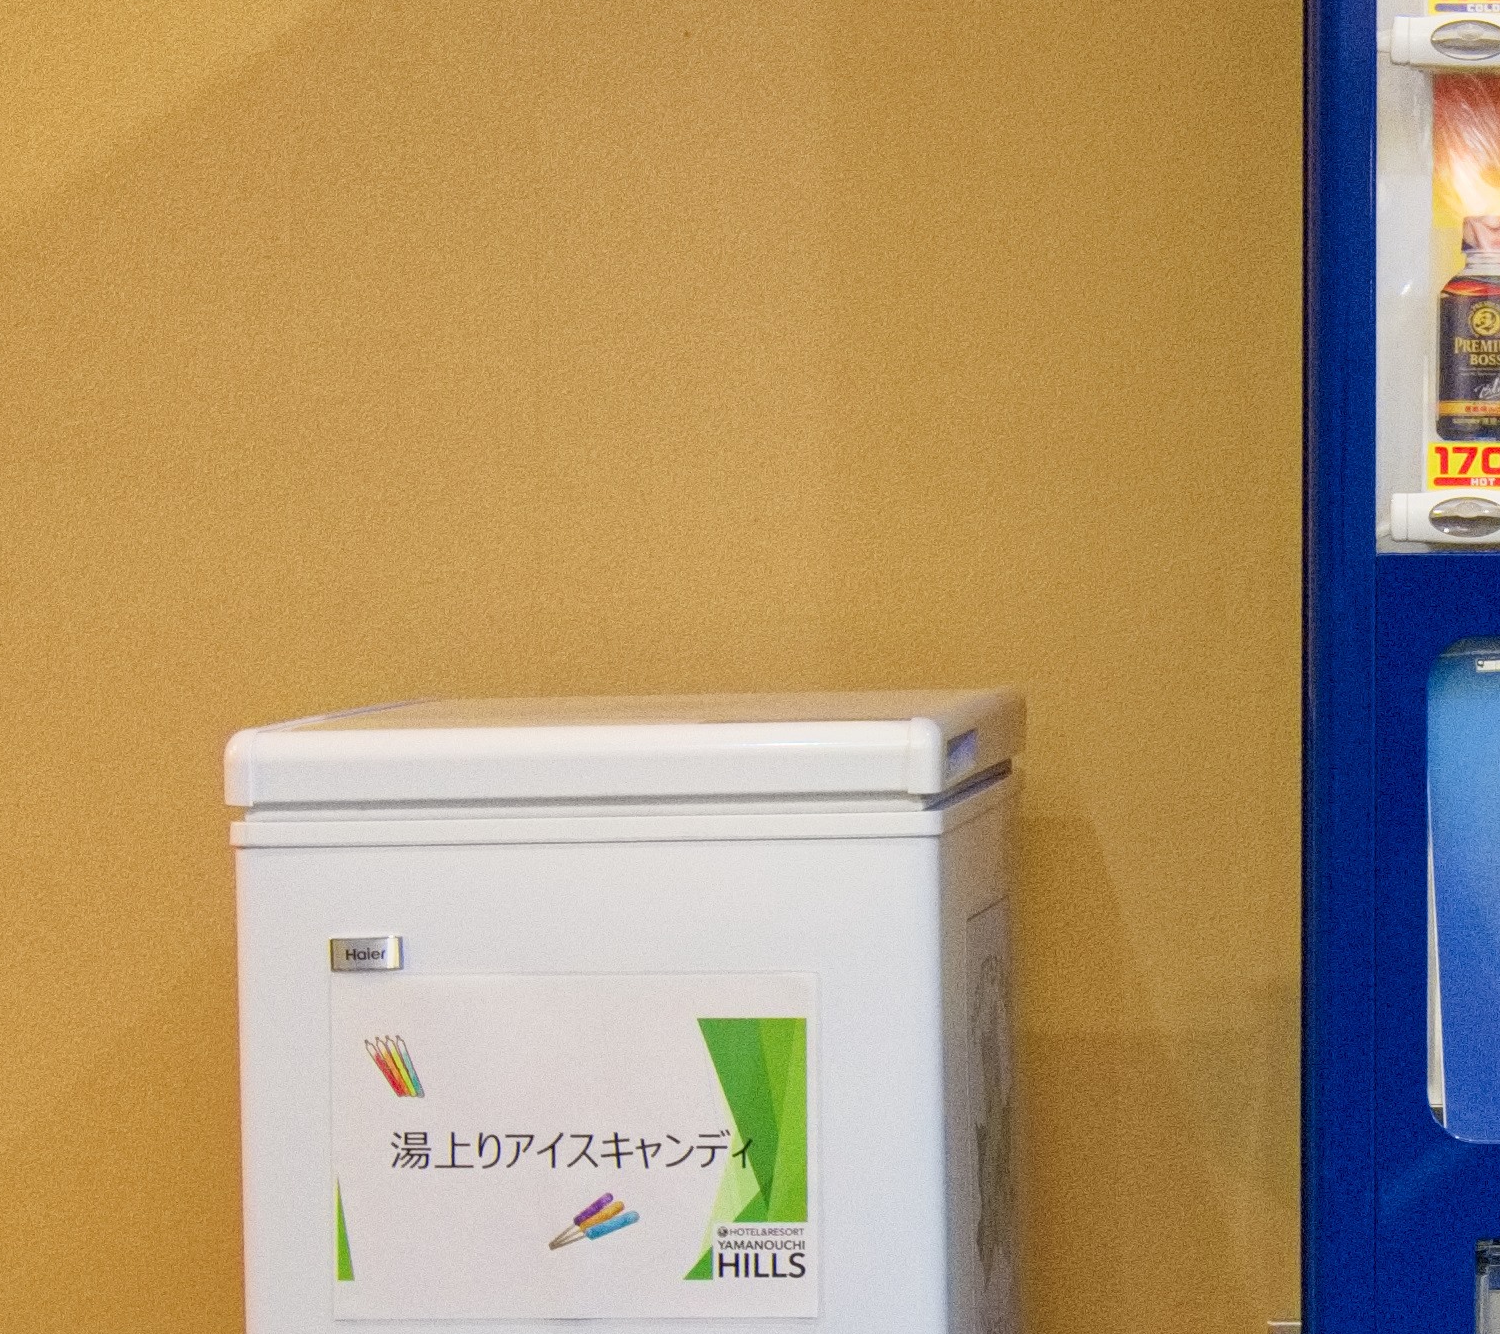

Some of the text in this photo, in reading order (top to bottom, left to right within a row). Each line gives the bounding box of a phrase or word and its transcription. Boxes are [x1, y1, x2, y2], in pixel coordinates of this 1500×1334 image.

[1470, 478, 1495, 487] HOT
[344, 947, 387, 961] Haier
[390, 1129, 754, 1170] 湯上りアイスキャンディ
[729, 1227, 804, 1236] HOTEL&RESORT
[716, 1239, 806, 1251] YAMANOUCHI
[716, 1251, 806, 1279] HILLS
